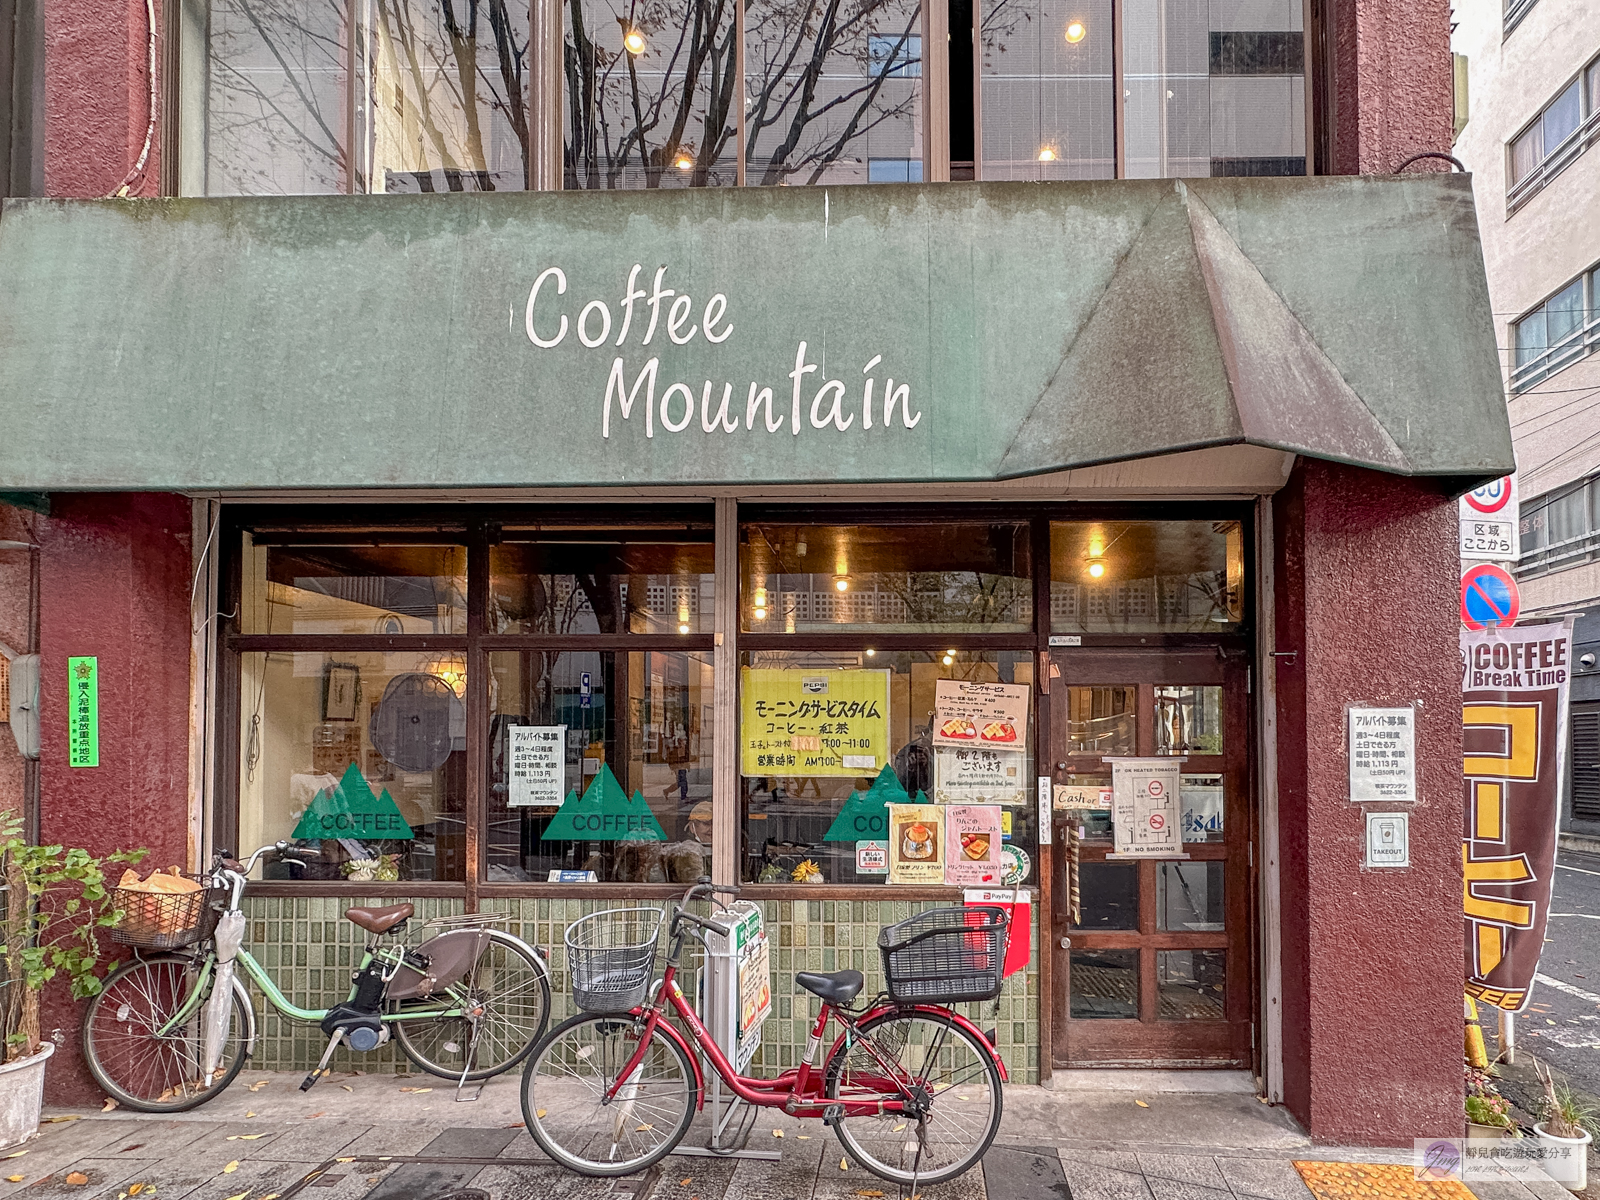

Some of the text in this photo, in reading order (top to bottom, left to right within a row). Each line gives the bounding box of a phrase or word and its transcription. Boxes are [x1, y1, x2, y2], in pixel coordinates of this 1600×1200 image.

[525, 264, 734, 349] Coffee
[602, 341, 922, 438] Mountain
[1474, 523, 1500, 536] 区域
[1464, 538, 1510, 551] ここから
[1474, 637, 1567, 670] COFFEE
[1473, 668, 1566, 687] Break Time
[959, 684, 1005, 693] モーニングサービス
[755, 700, 881, 719] モーニングサービスタイム
[1355, 716, 1407, 726] アルバイト募集
[766, 722, 850, 735] コーヒー・紅茶
[514, 732, 559, 741] アルバイト募集
[1355, 741, 1397, 750] 土日できる方
[757, 753, 796, 767] 営業時間
[961, 761, 1002, 772] ございます
[1355, 759, 1399, 768] 時給 1,113 円
[1058, 790, 1085, 803] Cash
[320, 813, 401, 831] COFFEE
[572, 814, 653, 832] COFFEE
[738, 1032, 759, 1069] マウンテン
